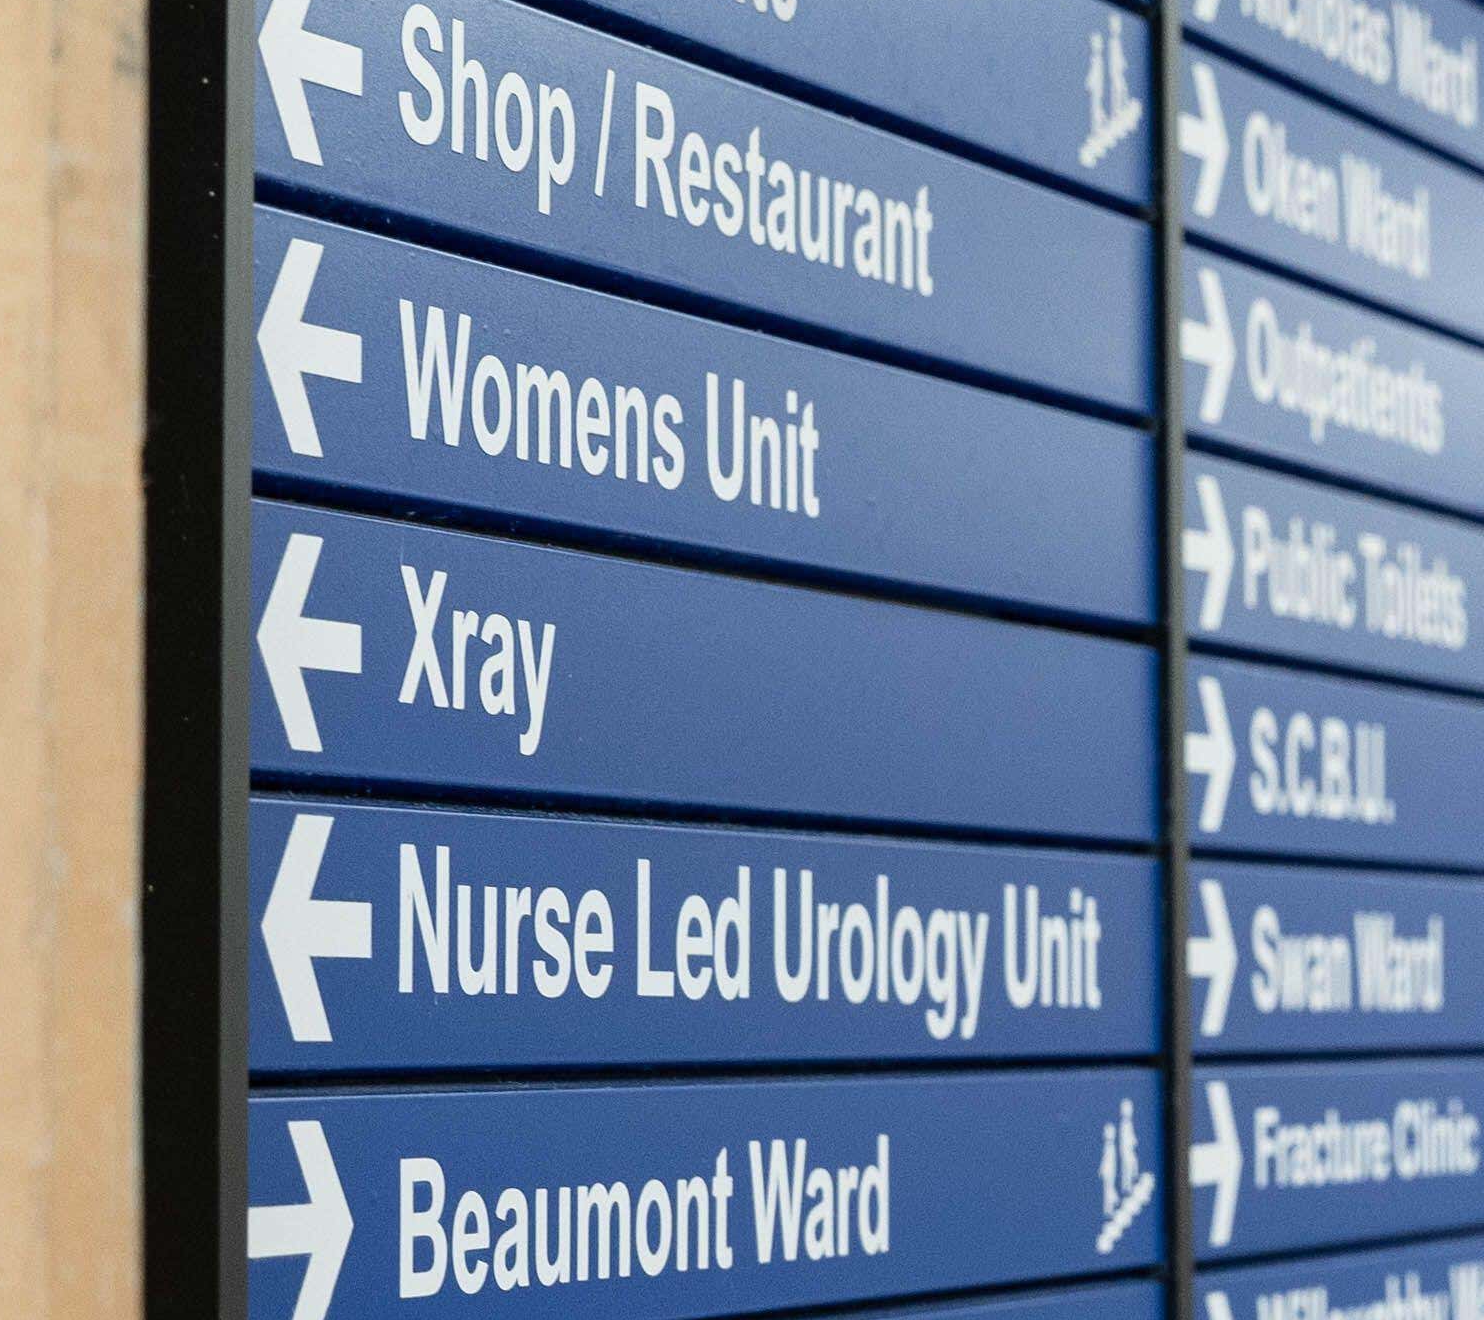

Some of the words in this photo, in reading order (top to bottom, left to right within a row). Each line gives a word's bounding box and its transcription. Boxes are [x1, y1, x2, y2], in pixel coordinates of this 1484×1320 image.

[1393, 0, 1480, 128] Ward
[398, 4, 576, 215] Shop
[594, 68, 616, 197] /
[634, 81, 934, 296] Restaurant
[1242, 110, 1340, 244] Oken
[1340, 152, 1431, 281] Ward
[398, 298, 686, 490] Womens
[704, 371, 822, 519] Unit
[1246, 296, 1446, 457] Outpatients
[398, 564, 556, 755] Xray
[1241, 504, 1357, 631] Public
[1358, 531, 1469, 652] Toilets
[397, 843, 615, 998] Nurse
[637, 858, 752, 1001] Led
[773, 865, 989, 1039] Urology
[1002, 883, 1103, 1010] Unit
[1250, 904, 1351, 1014] Swan
[1353, 911, 1444, 1013] Ward
[398, 1146, 734, 1299] Beaumont
[748, 1134, 891, 1266] Ward
[1253, 1106, 1392, 1190] Fracture
[1393, 1097, 1481, 1180] Clinic
